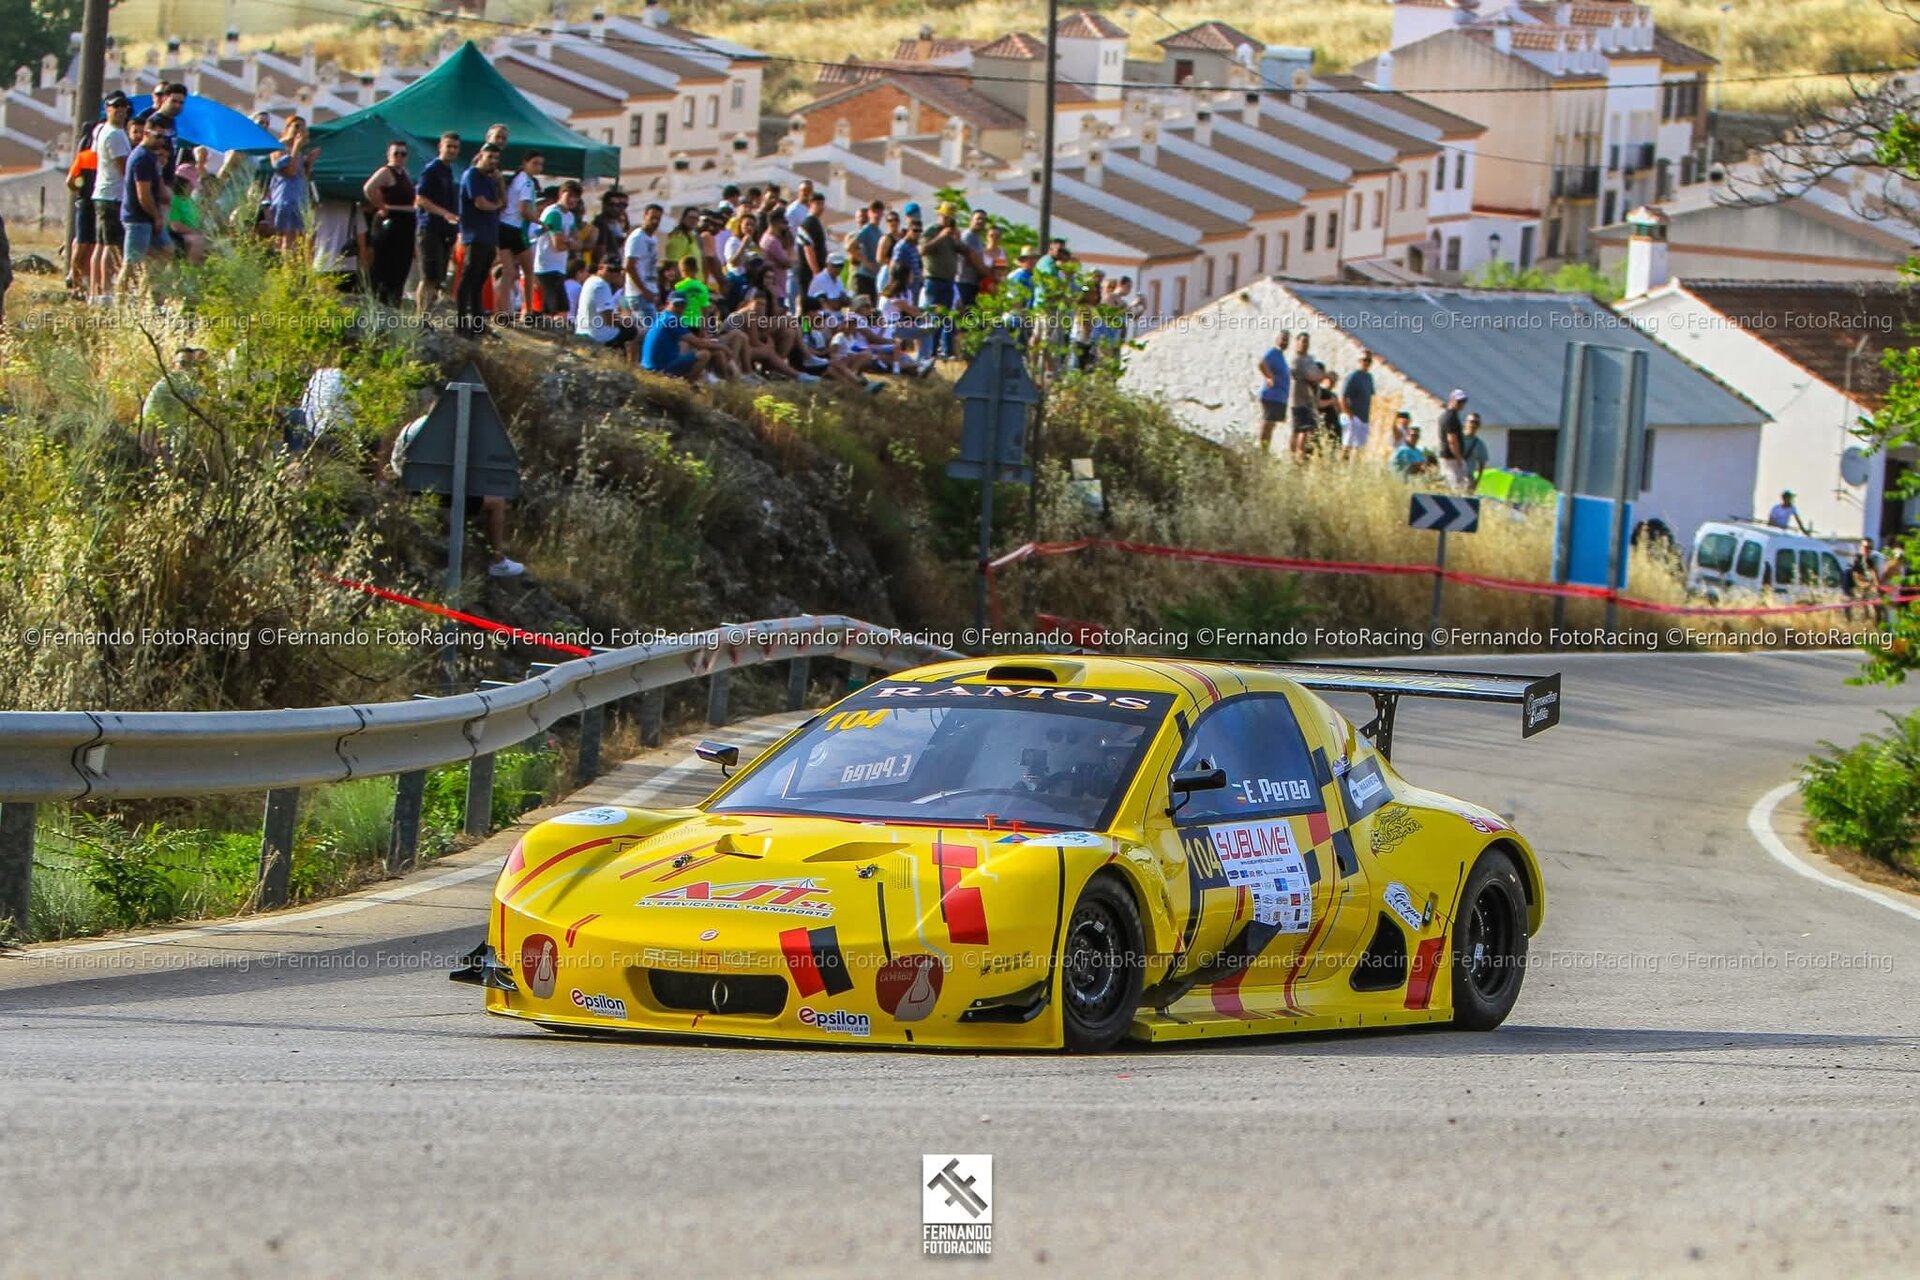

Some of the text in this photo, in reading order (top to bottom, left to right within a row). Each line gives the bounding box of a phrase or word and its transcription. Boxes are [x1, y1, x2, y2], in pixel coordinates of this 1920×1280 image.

[870, 685, 1151, 710] RAMOS
[824, 708, 892, 731] 104
[1242, 778, 1311, 804] E.Perea
[1184, 826, 1292, 880] 104 SUBLIME!
[644, 880, 832, 905] AJT
[745, 904, 830, 918] TRANSPORTE
[572, 989, 625, 1010] epsilon
[798, 1008, 869, 1027] epsilon
[827, 1025, 869, 1033] publicidad
